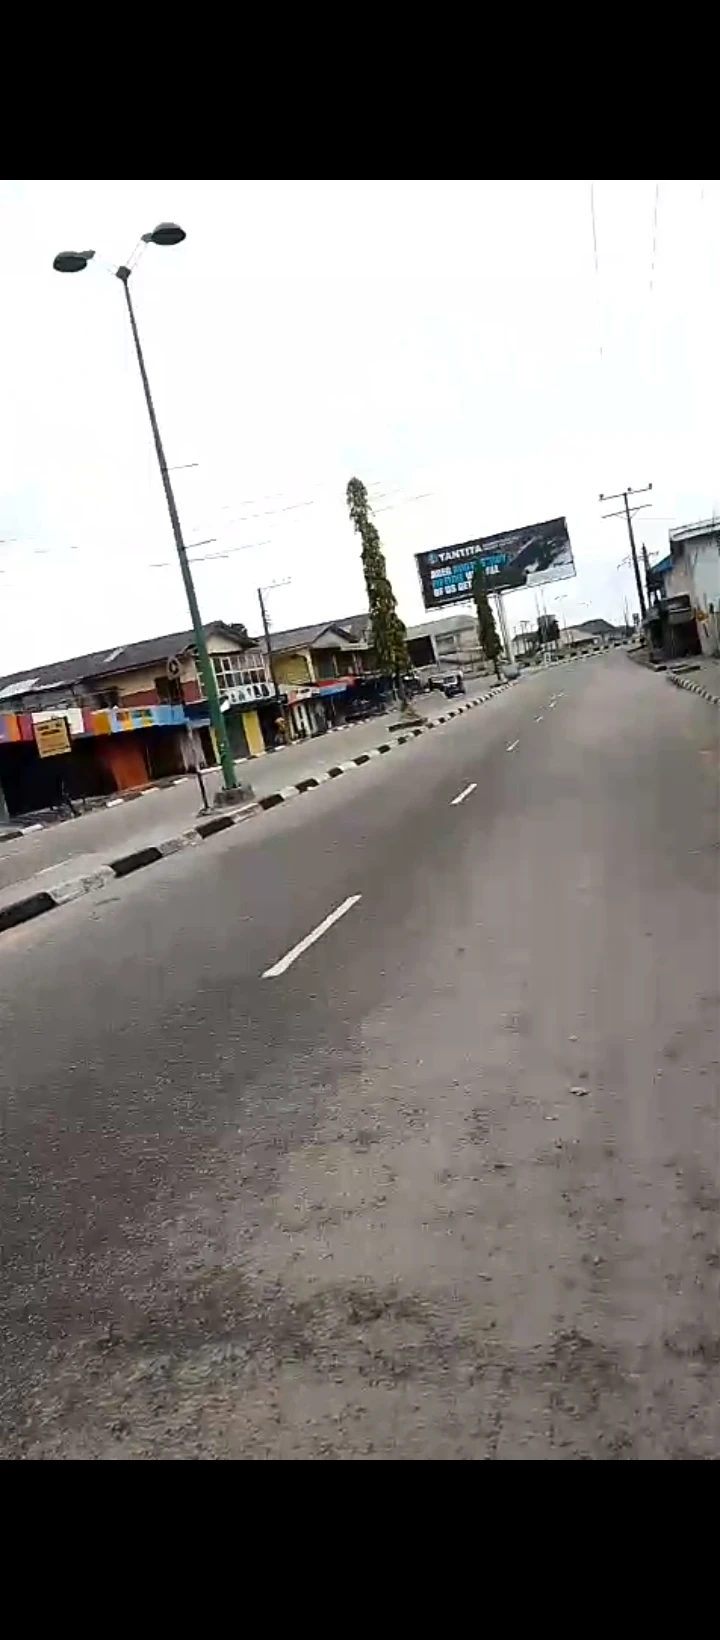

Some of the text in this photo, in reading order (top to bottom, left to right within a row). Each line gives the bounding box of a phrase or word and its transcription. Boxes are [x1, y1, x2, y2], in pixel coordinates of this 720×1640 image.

[437, 545, 482, 562] TANTITA
[444, 585, 457, 594] US
[457, 580, 473, 591] GET
